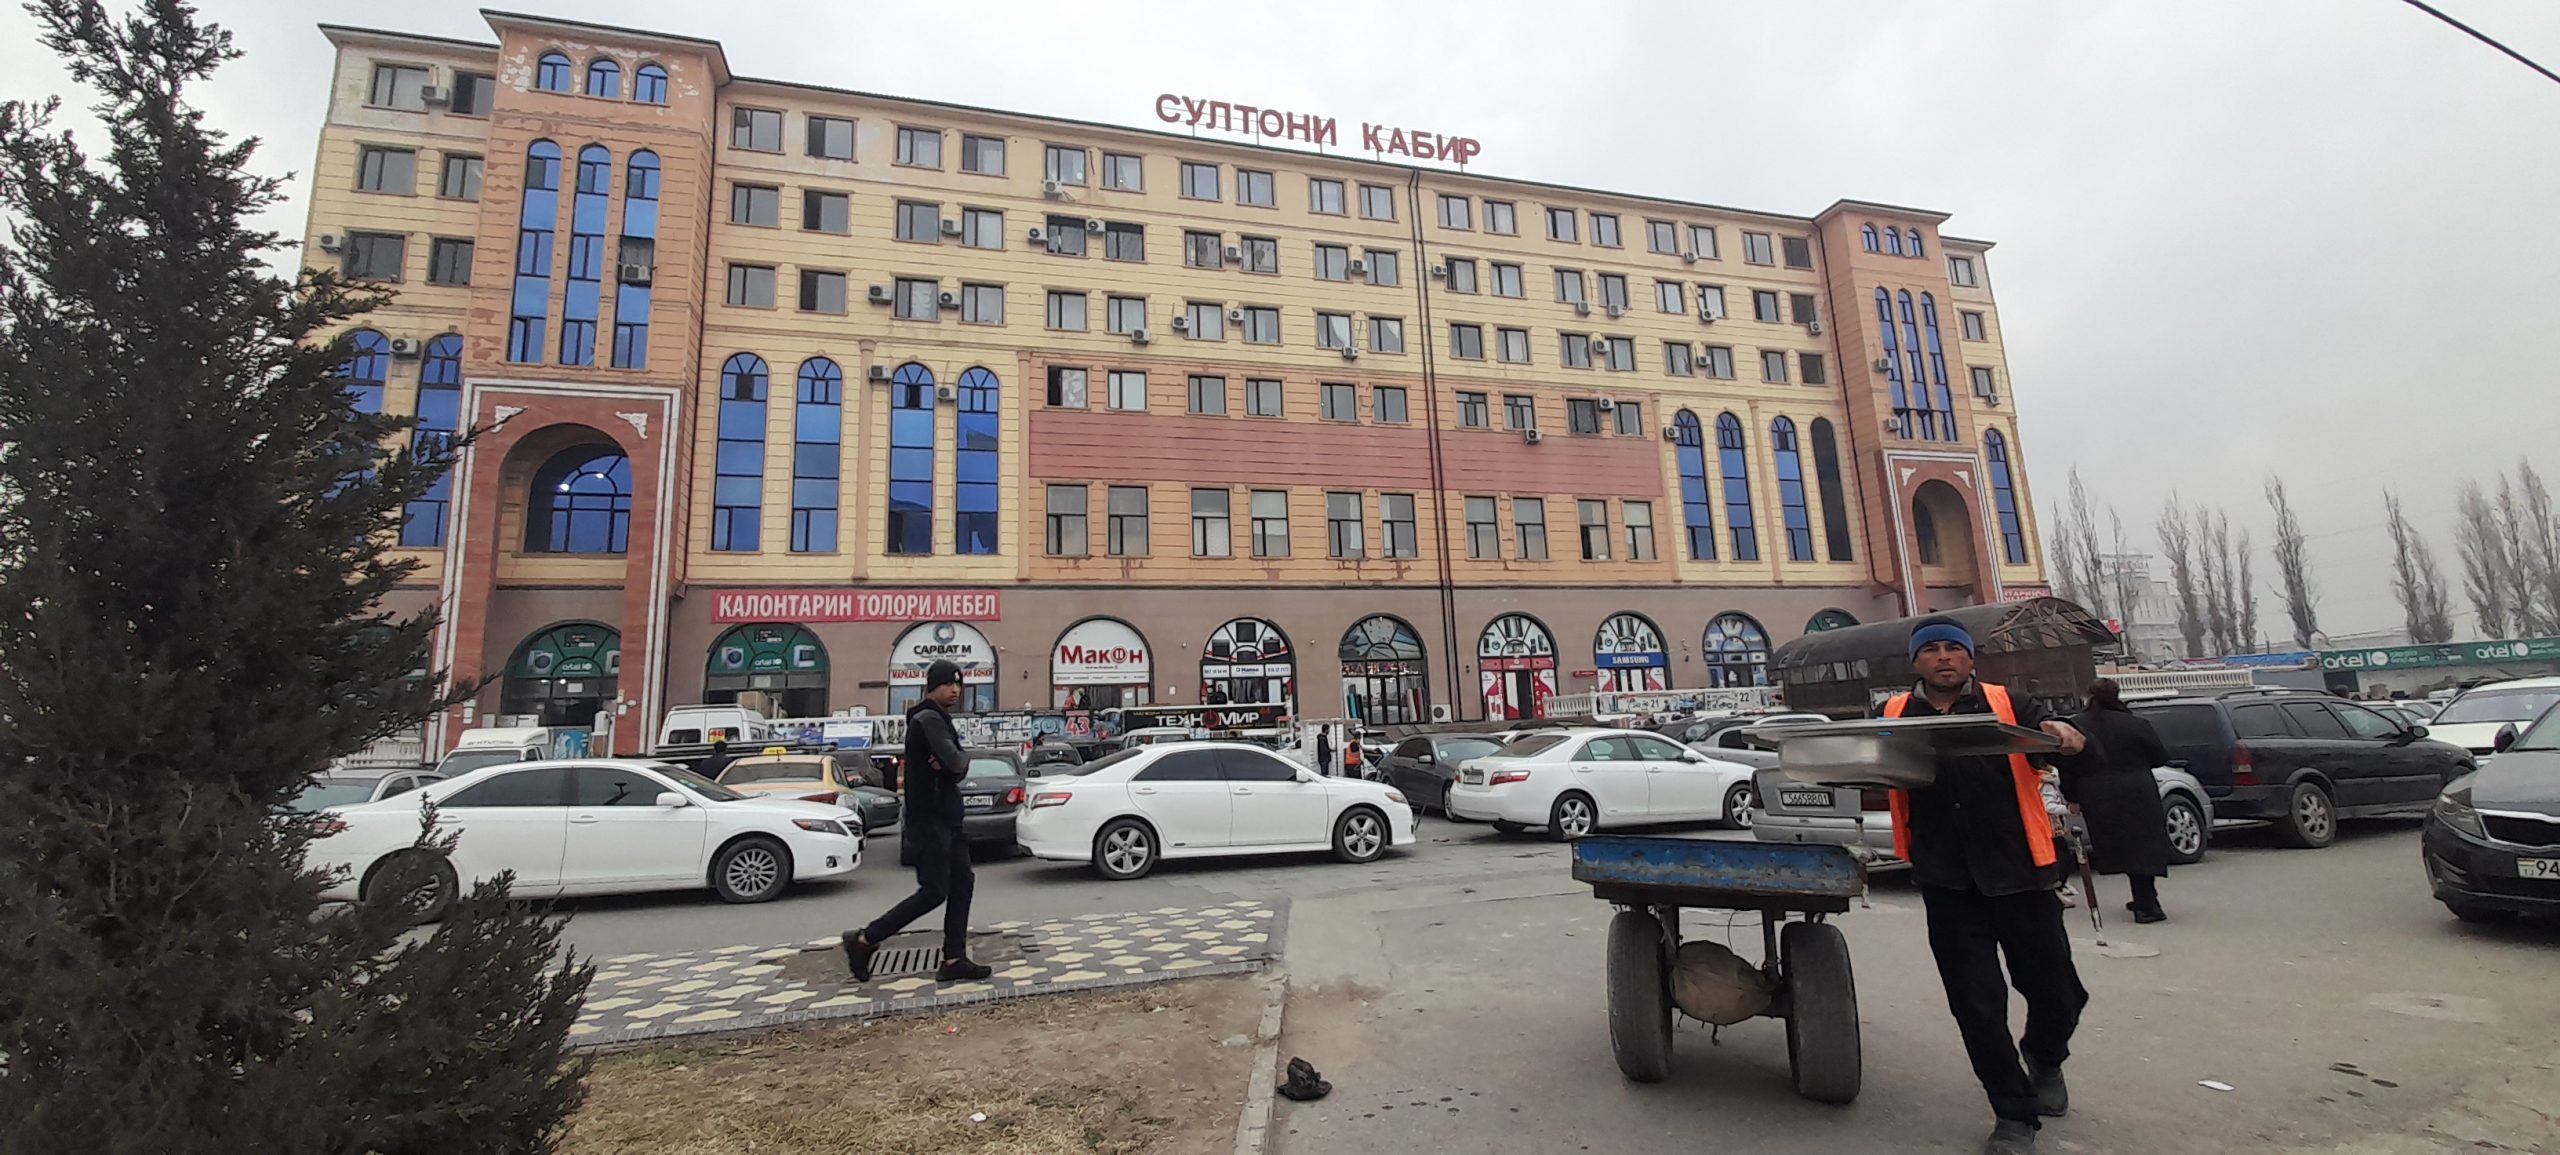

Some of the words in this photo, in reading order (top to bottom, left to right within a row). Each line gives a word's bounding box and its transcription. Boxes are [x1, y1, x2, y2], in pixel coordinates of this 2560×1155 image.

[1155, 93, 1337, 146] СУЛТОНИ
[1362, 122, 1481, 165] КАБИР
[718, 594, 852, 618] КАЛОНТАРИН
[913, 644, 960, 655] САРВАТ
[962, 644, 972, 654] М
[2475, 644, 2509, 659] artel
[1612, 655, 1650, 665] SAMSUNG
[2323, 653, 2364, 669] artel
[1650, 699, 1660, 708] 21
[1739, 692, 1750, 702] 22
[1065, 716, 1090, 737] 43
